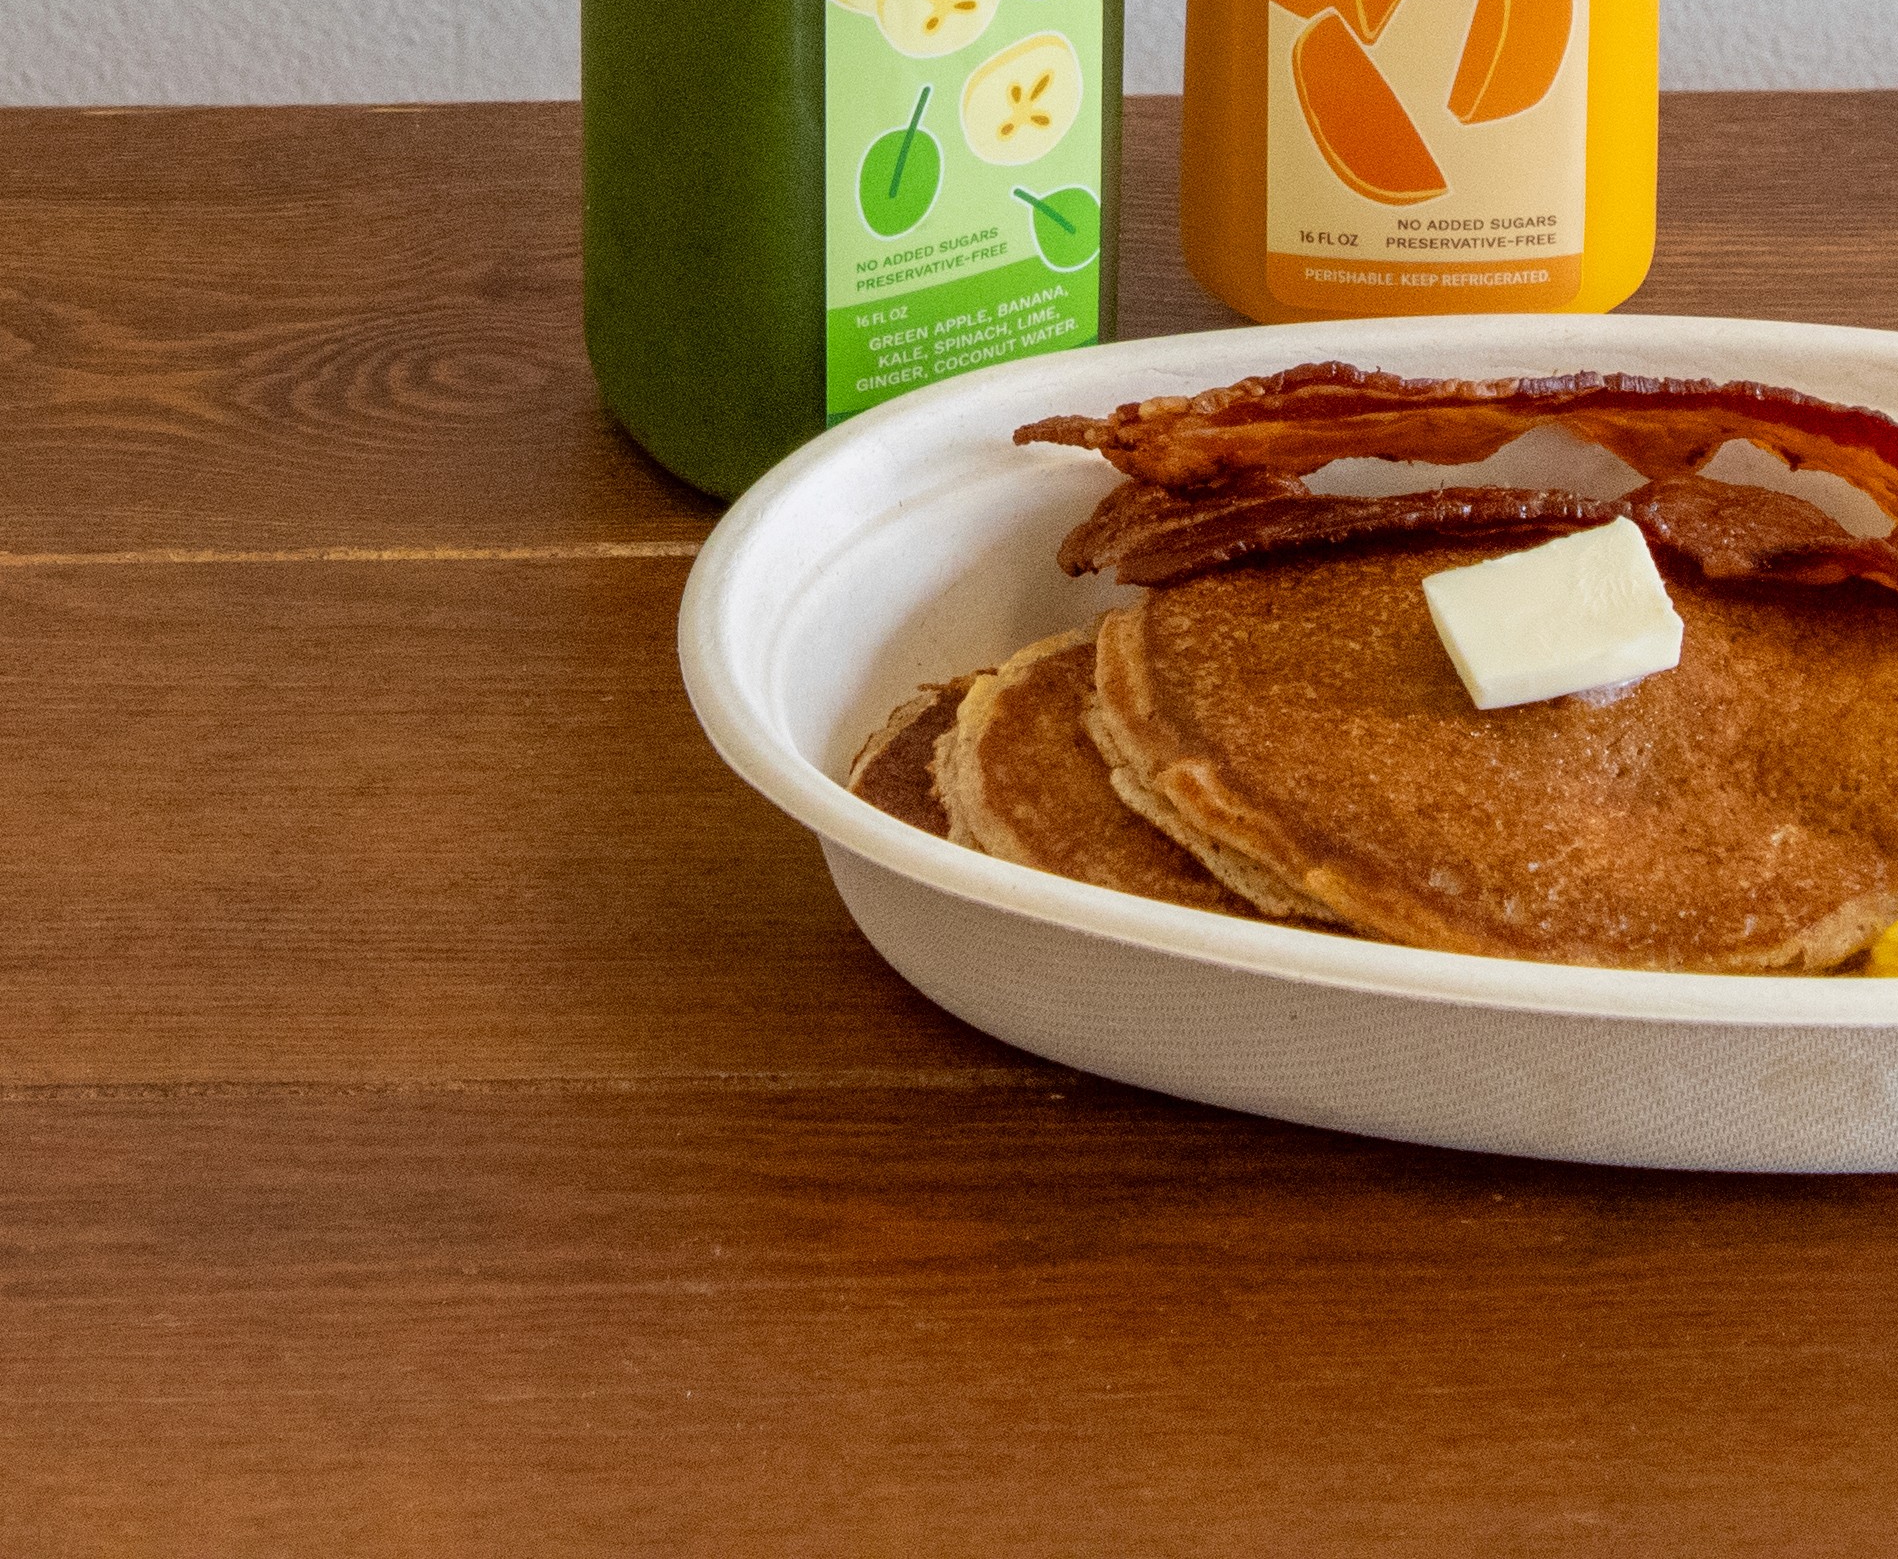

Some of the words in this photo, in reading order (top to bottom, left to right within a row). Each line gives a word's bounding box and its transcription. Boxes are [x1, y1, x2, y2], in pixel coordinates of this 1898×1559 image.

[1300, 230, 1314, 244] 16
[1318, 232, 1334, 245] FL
[1338, 234, 1359, 246] OZ
[1397, 218, 1422, 230] NO
[1427, 218, 1484, 231] ADDED
[1490, 215, 1557, 229] SUGARS
[856, 260, 877, 273] NO
[882, 245, 934, 268] ADDED
[939, 227, 999, 253] SUGARS
[1386, 233, 1556, 249] PRESERVATIVE-FREE
[856, 242, 1008, 292] PRESERVATIVE-FREE
[1401, 273, 1438, 286] KEEP
[1442, 269, 1551, 286] REFRIGERATED.
[856, 315, 869, 328] 16
[872, 312, 885, 325] FL
[889, 307, 908, 321] OZ
[869, 328, 928, 352] GREEN
[934, 309, 992, 335] APPLE,
[998, 285, 1069, 318] BANANA,
[878, 346, 928, 368] KALE,
[934, 324, 1012, 355] SPINACH,
[1017, 307, 1060, 329] LIME,
[856, 364, 928, 392] GINGER,
[934, 340, 1016, 374] COCONUT
